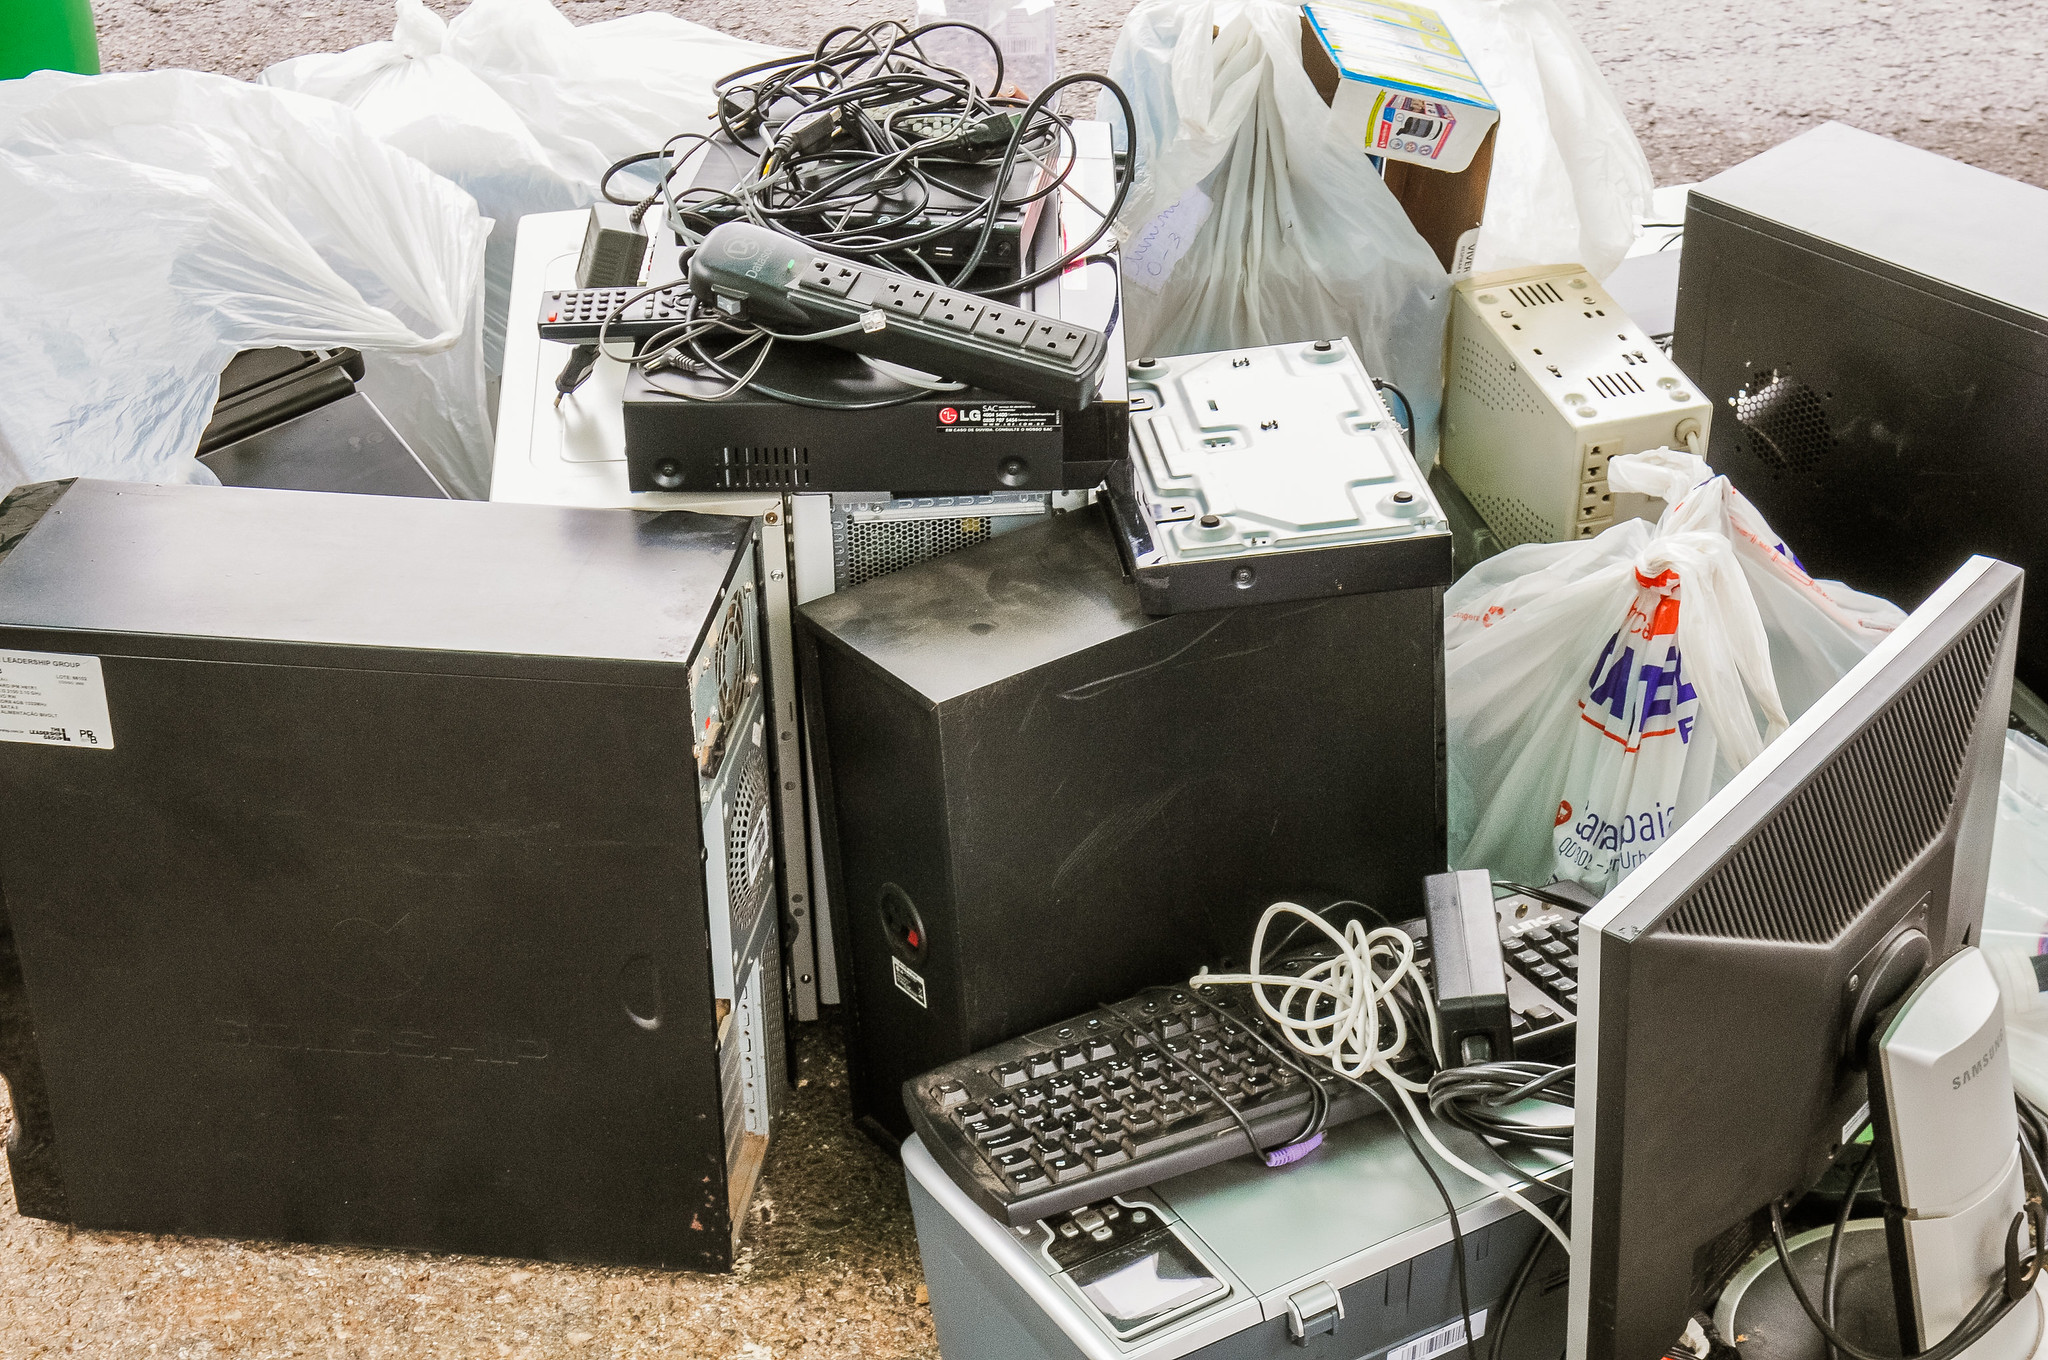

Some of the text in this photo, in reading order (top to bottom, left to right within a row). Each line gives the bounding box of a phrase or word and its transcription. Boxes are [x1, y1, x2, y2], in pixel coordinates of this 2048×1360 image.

[982, 404, 999, 412] SAC
[959, 409, 982, 421] LG
[2, 657, 81, 668] LEADERSHIP GROUP
